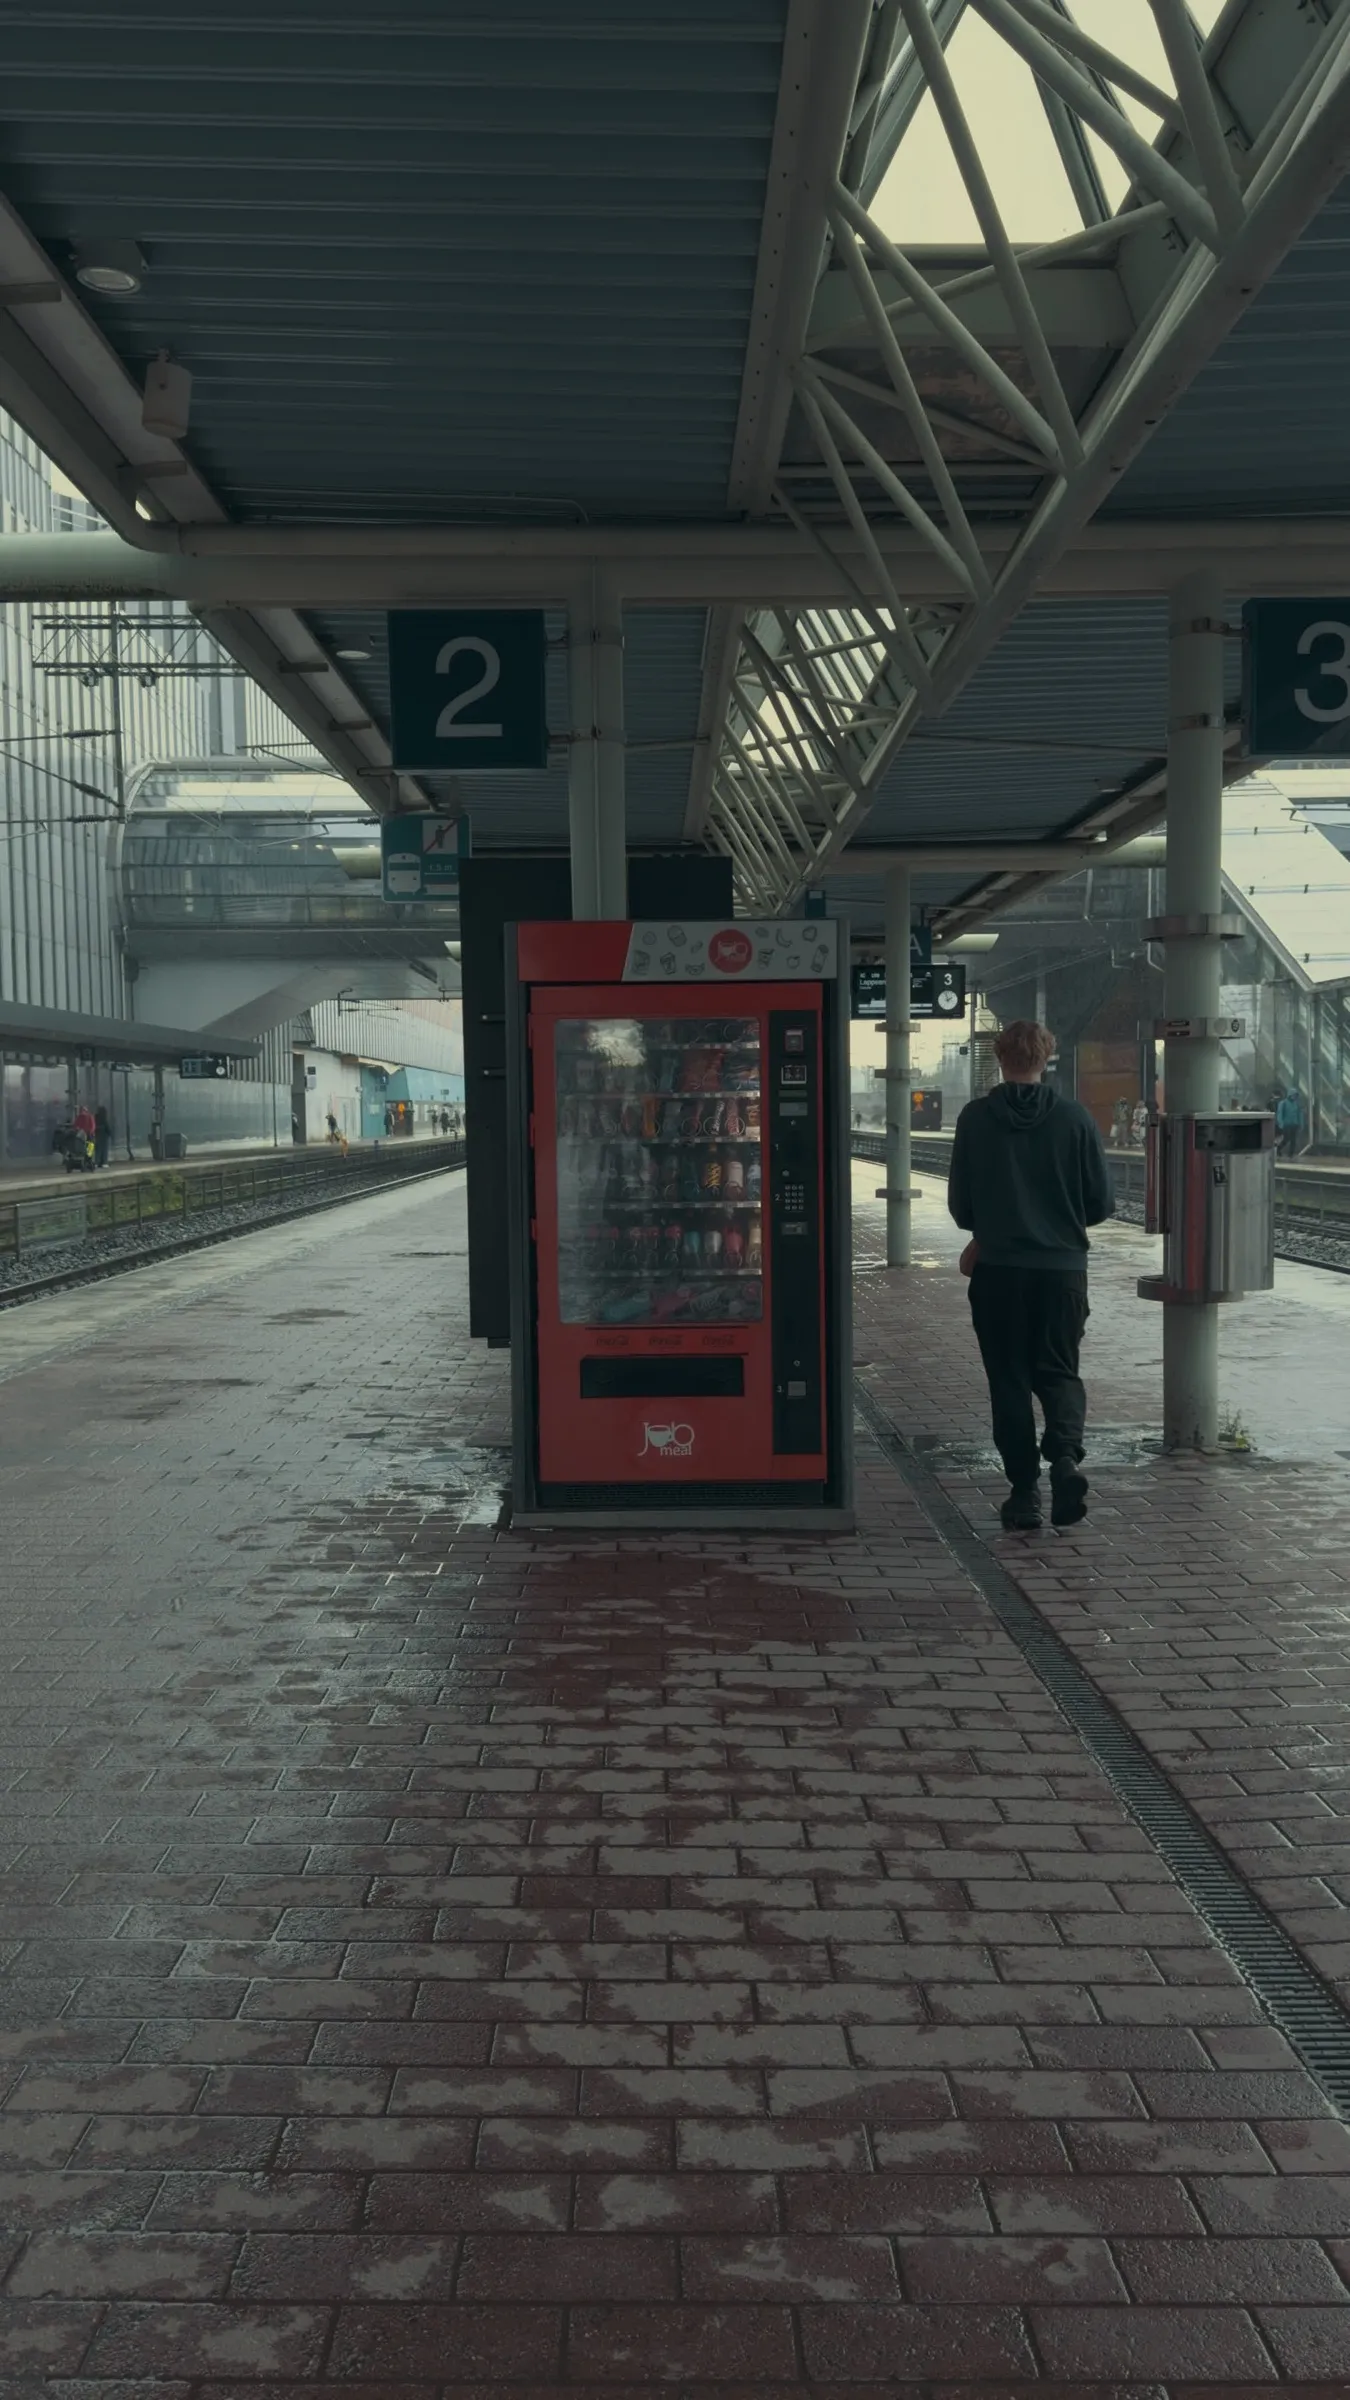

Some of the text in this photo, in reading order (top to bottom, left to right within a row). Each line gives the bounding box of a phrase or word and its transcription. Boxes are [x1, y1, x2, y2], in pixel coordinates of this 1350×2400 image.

[1294, 620, 1350, 723] 3
[435, 635, 503, 738] 2
[910, 933, 923, 957] A
[944, 973, 953, 986] 3
[660, 1443, 693, 1456] meal
